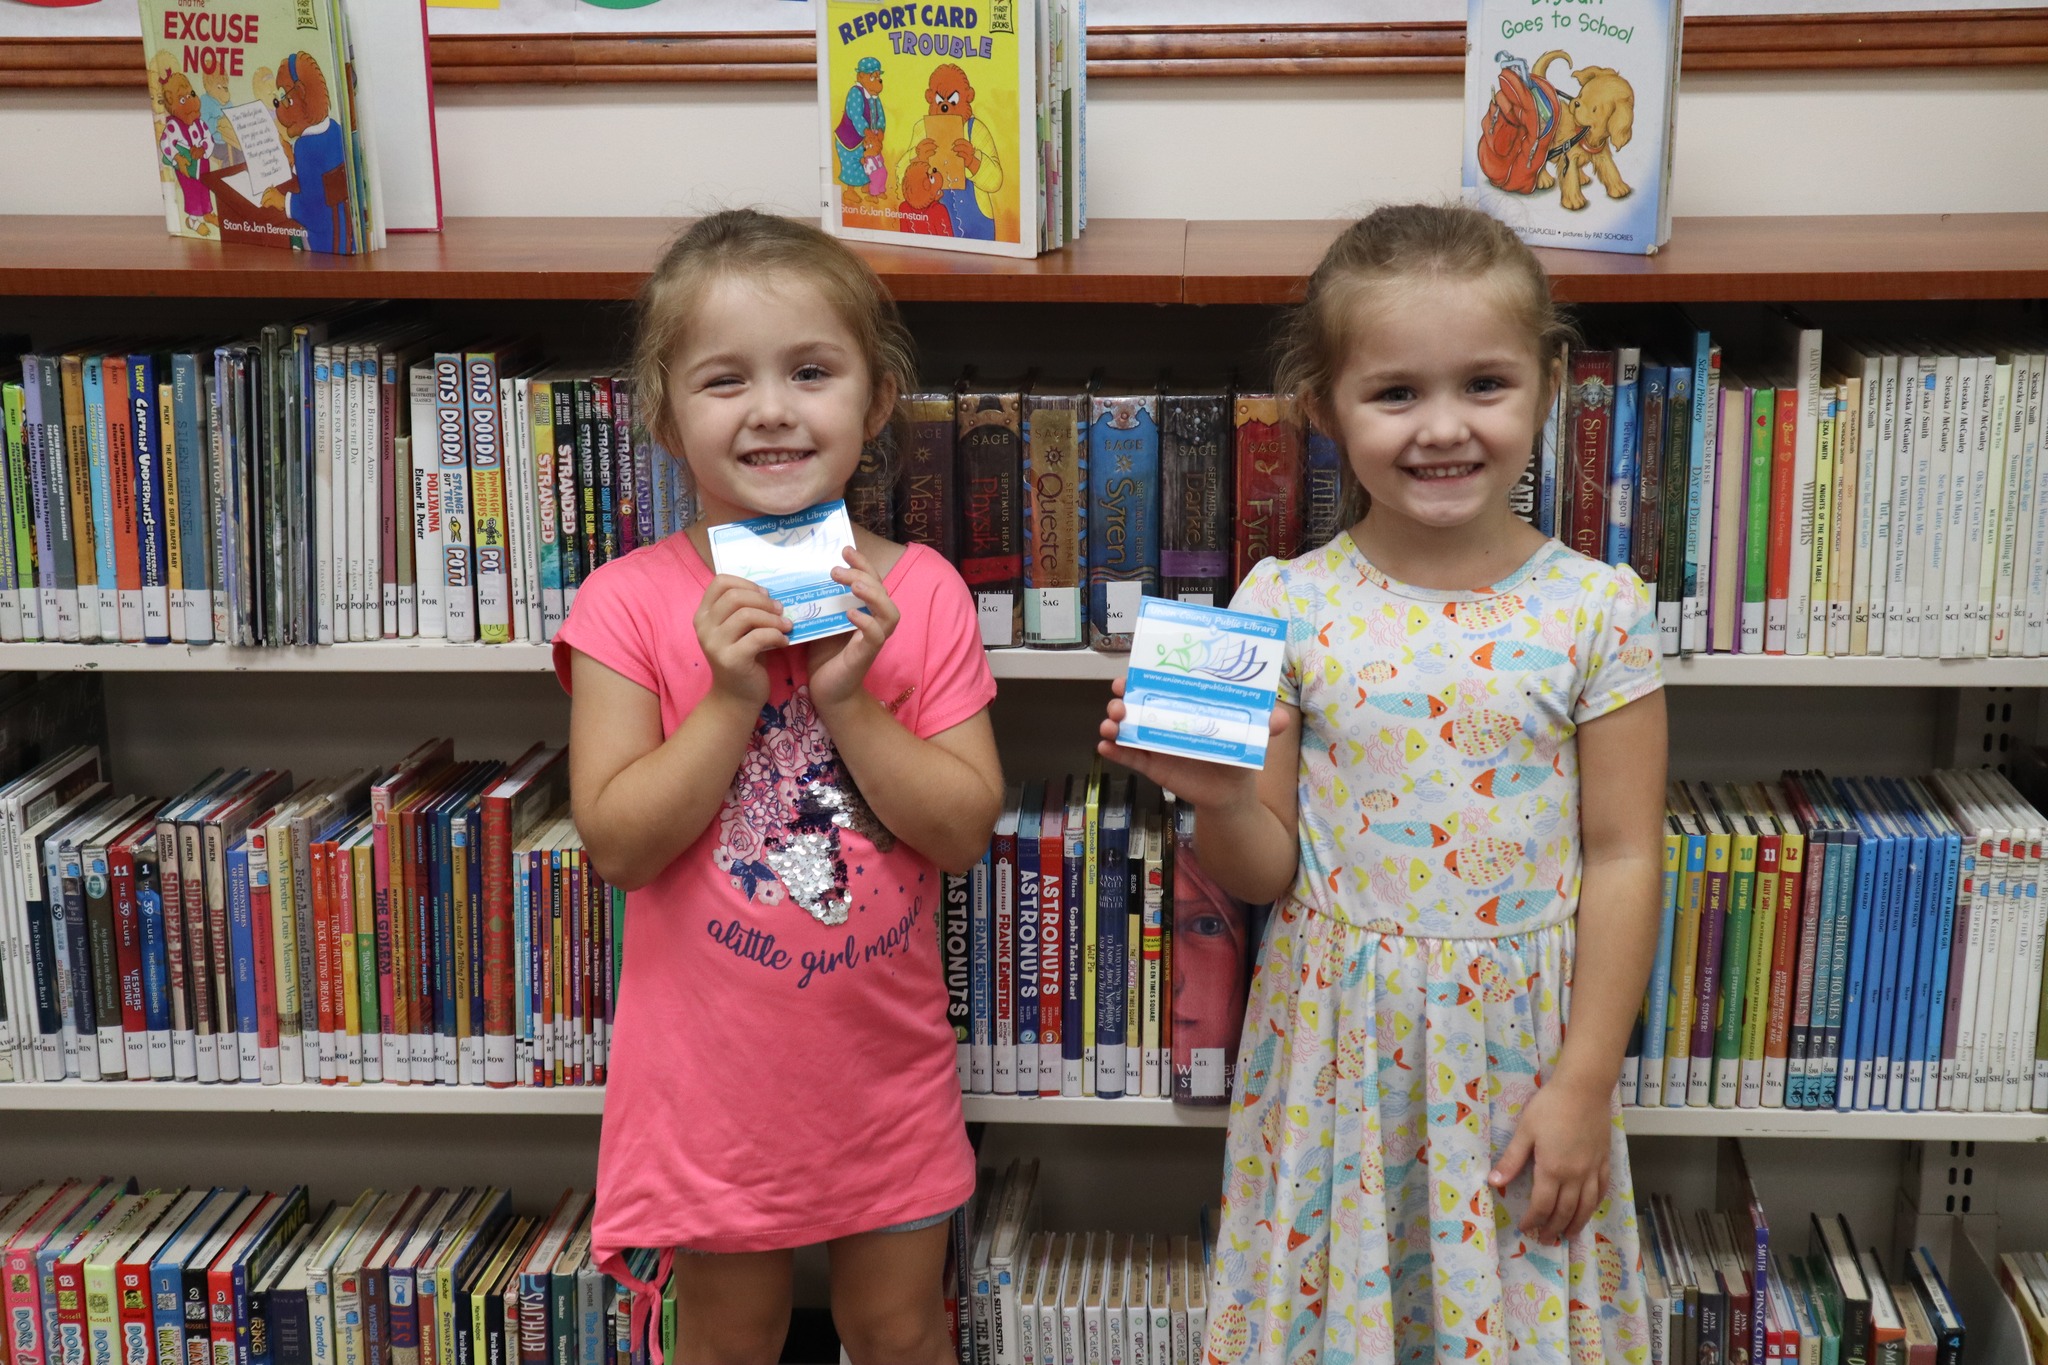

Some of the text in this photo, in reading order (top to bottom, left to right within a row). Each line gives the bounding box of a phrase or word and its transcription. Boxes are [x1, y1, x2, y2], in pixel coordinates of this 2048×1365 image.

[164, 11, 258, 44] EXCUSE
[838, 4, 977, 45] REPORT CARD
[992, 22, 1009, 30] BOOKS
[993, 13, 1007, 21] TIME
[1502, 11, 1634, 43] Goes to School
[183, 45, 244, 76] NOTE
[889, 31, 992, 59] TROUBLE
[223, 219, 242, 230] Stan
[251, 222, 266, 233] Jan
[267, 223, 308, 237] Berenstain
[867, 206, 883, 217] Jan
[885, 207, 928, 221] Berenstain
[176, 367, 187, 403] Pinkney
[1885, 378, 1893, 411] Scieszka
[438, 363, 461, 464] OTIS DOODA
[471, 363, 495, 465] OTIS DOODA
[1035, 428, 1072, 438] SAGE
[1901, 377, 1914, 454] Scieszka McCauley
[972, 434, 1009, 445] SAGE
[1104, 439, 1144, 451] SAGE
[1179, 445, 1217, 456] SAGE
[1249, 442, 1286, 453] SAGE
[580, 424, 595, 534] STRANDED SHADOW ISLAND
[617, 426, 632, 500] STRANDED
[1582, 419, 1601, 510] SPLENDORS
[1704, 440, 1714, 484] SURPRISE
[138, 453, 156, 525] UNDERPANTS
[168, 497, 173, 505] OF
[415, 468, 425, 539] Eleanor H. Porter
[426, 473, 440, 533] POLLYANNA
[443, 473, 454, 514] BUT TRUE
[452, 473, 464, 515] STRANGE
[475, 471, 488, 517] DANGEROUS
[537, 454, 555, 544] STRANDED
[558, 444, 576, 534] STRANDED
[1618, 422, 1633, 558] Between the Dragon and the
[1818, 484, 1826, 510] KNIGHTS
[748, 519, 776, 533] County
[779, 514, 803, 526] Public
[965, 477, 998, 553] Physik
[1001, 472, 1009, 553] SEPTIMUS HEAP
[1036, 473, 1063, 570] Queste
[1099, 478, 1135, 564] Syren
[1242, 498, 1274, 562] Fyre
[1688, 467, 1702, 554] DAY OF DELIGHT
[1801, 481, 1815, 546] WHOPPERS
[1879, 522, 1889, 538] Tut
[1816, 537, 1824, 562] KITCHEN
[1150, 607, 1277, 636] Union County Public Library
[1143, 673, 1261, 699] www.unioncountypubliclibrary.org
[114, 865, 128, 876] 11
[1715, 848, 1722, 860] 9
[1740, 848, 1753, 860] 10
[1764, 849, 1776, 861] 11
[1786, 848, 1797, 860] 12
[119, 902, 130, 916] 39
[208, 836, 225, 974] RIPKEN HOTHEAD
[161, 872, 184, 990] SQUEEZE PLAY
[376, 889, 391, 976] THE GOLEM
[797, 935, 860, 989] girl
[865, 896, 922, 962] magic
[947, 874, 969, 1017] ASTRONUTS
[999, 914, 1010, 959] FRANK
[1019, 870, 1038, 998] ASTRONUTS
[1042, 875, 1060, 995] ASTRONUTS
[317, 921, 329, 1012] DUCK HUNTING DREAMS
[331, 915, 344, 1015] TURKEY HUNT TRADITION
[1070, 907, 1079, 1001] Gopher Takes Heart
[1828, 915, 1847, 1019] SHERLOCK HOLMES
[123, 976, 133, 1006] RISING
[131, 969, 142, 1011] VESPERS
[1757, 1243, 1766, 1271] SMITH
[61, 1277, 72, 1285] 12
[15, 1310, 32, 1348] DORK
[520, 1291, 546, 1352] SACHAR
[995, 1295, 1004, 1356] SILVERSTEIN
